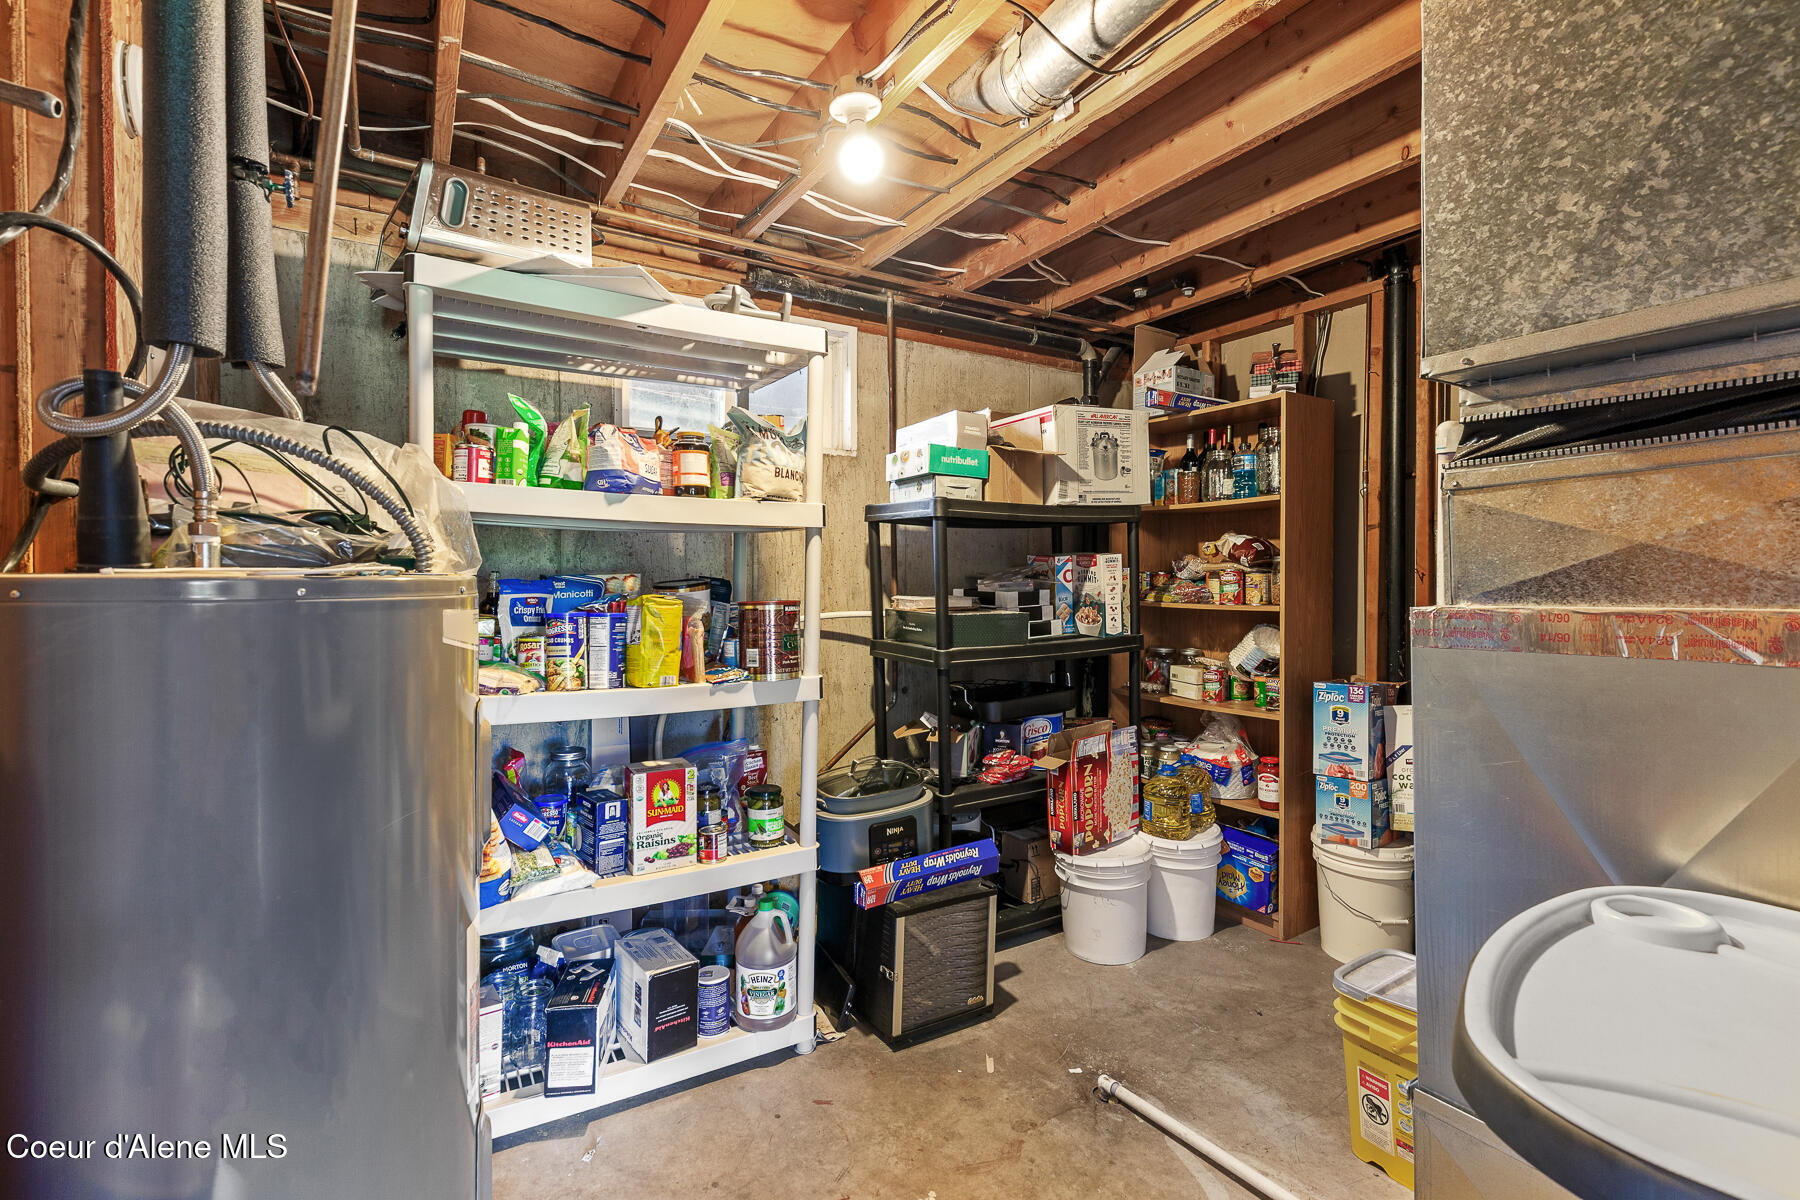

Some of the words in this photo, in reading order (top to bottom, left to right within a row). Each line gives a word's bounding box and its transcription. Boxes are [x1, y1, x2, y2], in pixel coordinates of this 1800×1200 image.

[941, 455, 979, 467] nutribullet
[513, 606, 535, 615] Crispy
[1540, 613, 1570, 623] 06/14
[1638, 614, 1674, 625] 324A
[1687, 617, 1758, 630] Nashua
[1540, 632, 1571, 643] 06/14
[1637, 635, 1674, 646] 324A
[1318, 690, 1345, 703] Ziploc
[1350, 686, 1364, 695] 136
[1336, 710, 1344, 718] 9
[1024, 723, 1048, 738] Crisco
[1322, 725, 1358, 735] PREMIUM
[1324, 731, 1356, 739] PROTECTION
[687, 769, 695, 780] 2
[1319, 781, 1339, 791] Ziploc
[1350, 782, 1367, 791] 200
[1057, 780, 1066, 830] POPCORN
[1084, 763, 1094, 843] POPCORN
[636, 832, 664, 841] Organic
[886, 827, 904, 836] NINJA
[636, 837, 676, 850] Raisins
[923, 855, 946, 868] Wrap
[945, 847, 979, 864] Reynolds
[898, 864, 921, 877] HEAVY
[900, 860, 918, 868] DUTY
[949, 864, 982, 882] Reynolds
[1221, 871, 1240, 882] Maid
[905, 878, 923, 888] DUTY
[926, 874, 949, 887] Wrap
[1218, 879, 1246, 892] Honey
[900, 883, 923, 896] HEAVY
[502, 962, 528, 973] MORTON
[750, 975, 774, 984] HEINZ
[654, 1015, 691, 1032] KitchenAid
[547, 1038, 591, 1048] KitchenAid
[1365, 1075, 1388, 1090] WARNING
